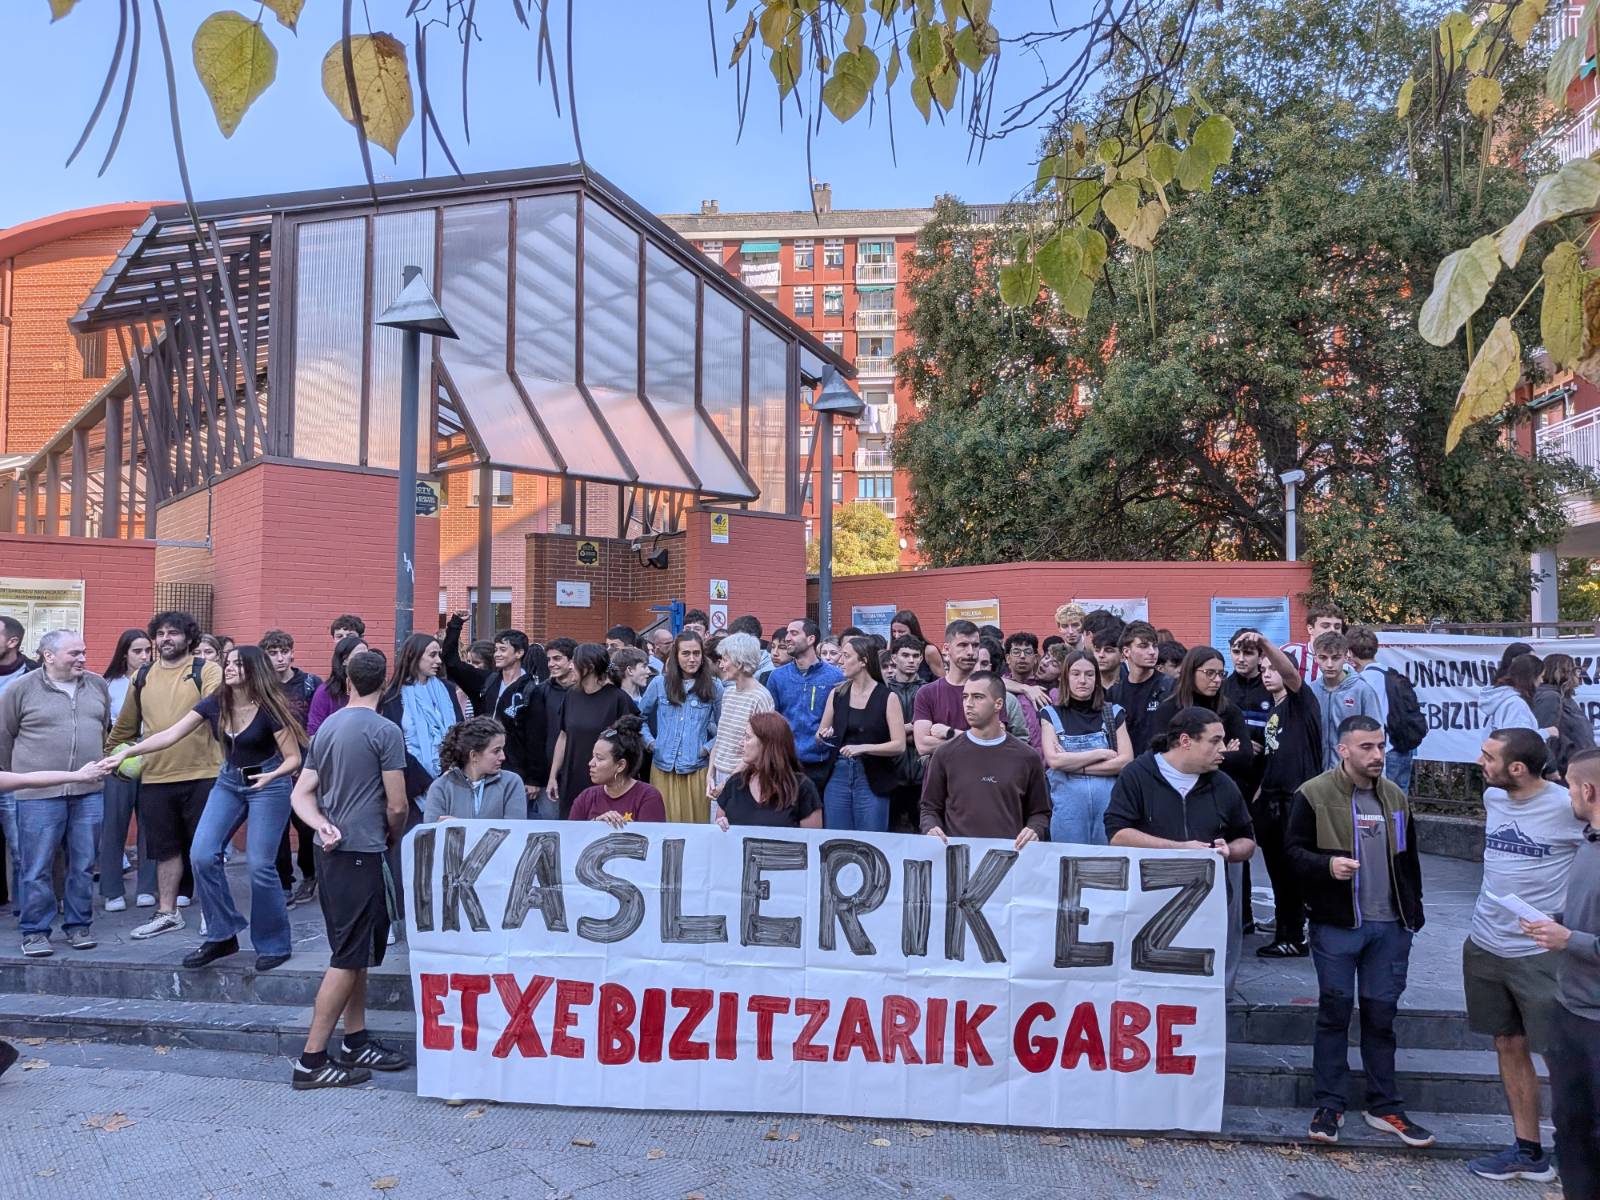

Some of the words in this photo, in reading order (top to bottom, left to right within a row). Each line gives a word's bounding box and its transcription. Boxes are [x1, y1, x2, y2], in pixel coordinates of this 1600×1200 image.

[413, 826, 1019, 964] IKASLERIK
[1053, 855, 1216, 977] EZ
[420, 973, 998, 1068] ETXEBIZITZARIK
[1013, 1000, 1198, 1075] GABE
